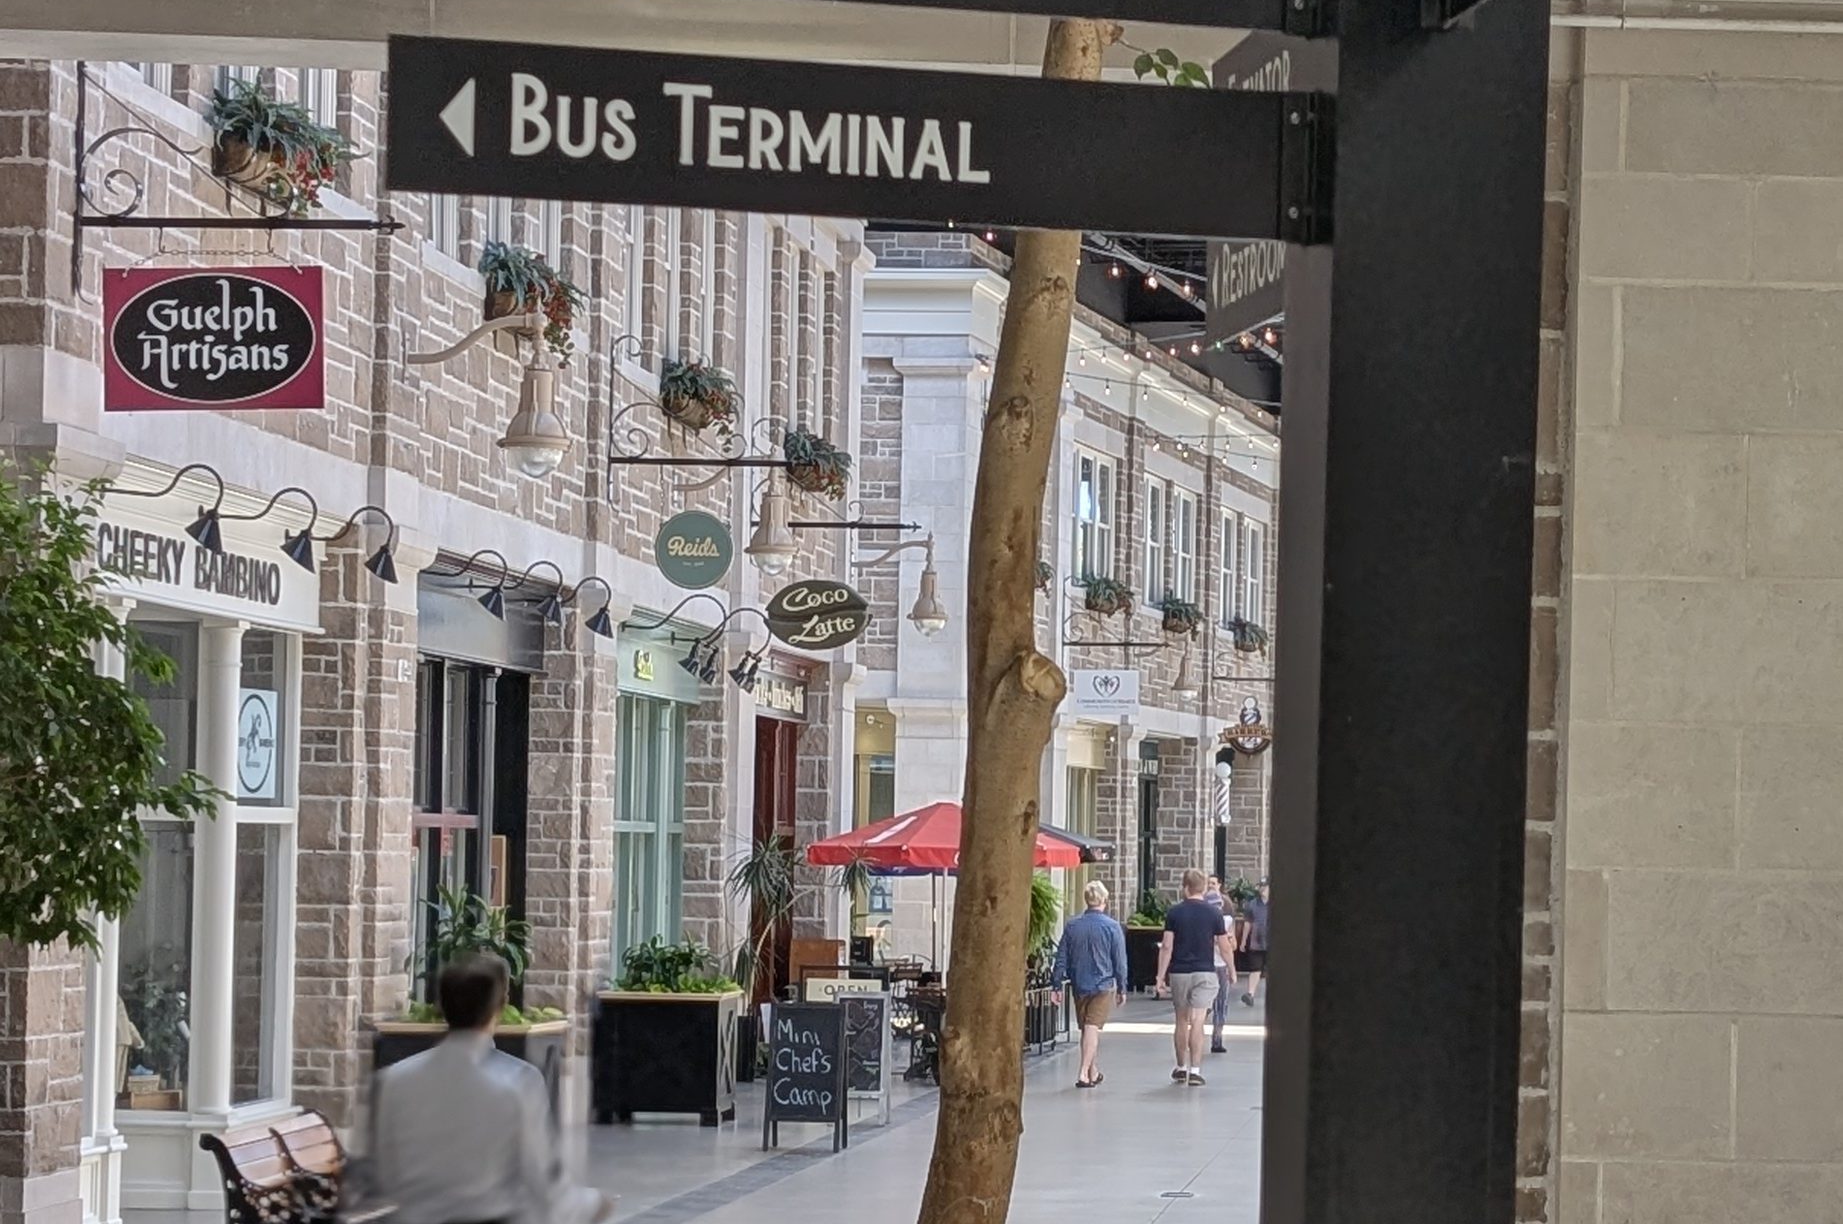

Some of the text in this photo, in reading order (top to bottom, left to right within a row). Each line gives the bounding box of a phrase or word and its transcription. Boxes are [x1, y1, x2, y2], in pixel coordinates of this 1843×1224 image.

[510, 72, 991, 184] BUS TERMINAL
[146, 278, 278, 342] Guelph
[136, 331, 290, 389] Artisans
[97, 522, 281, 606] CHEEKY BAMBINO
[667, 535, 721, 558] Reids
[782, 587, 849, 612] Coco
[787, 614, 856, 644] Latte
[773, 1077, 832, 1116] Camp
